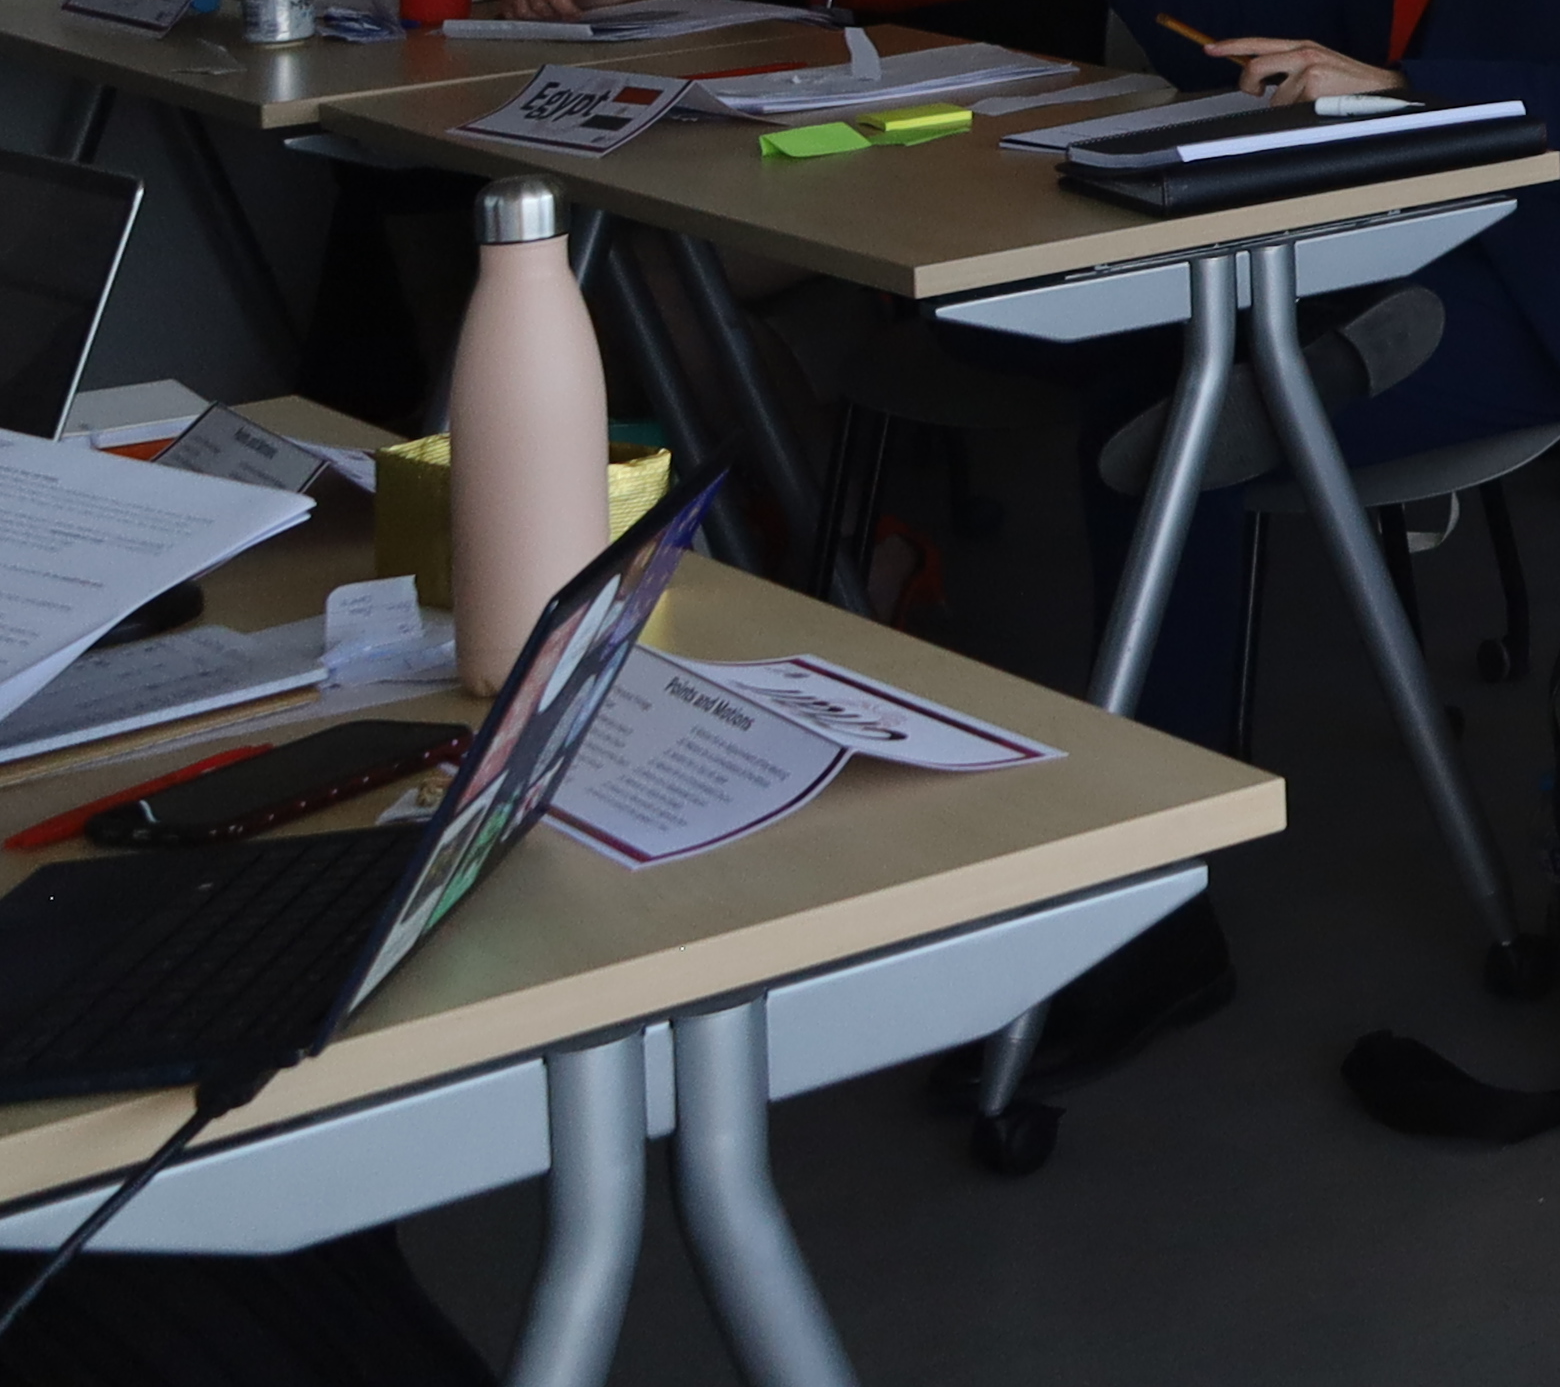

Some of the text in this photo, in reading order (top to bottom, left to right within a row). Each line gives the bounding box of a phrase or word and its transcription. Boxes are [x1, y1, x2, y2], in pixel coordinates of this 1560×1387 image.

[520, 82, 613, 123] Egypt
[664, 676, 697, 707] Points
[693, 691, 716, 712] and
